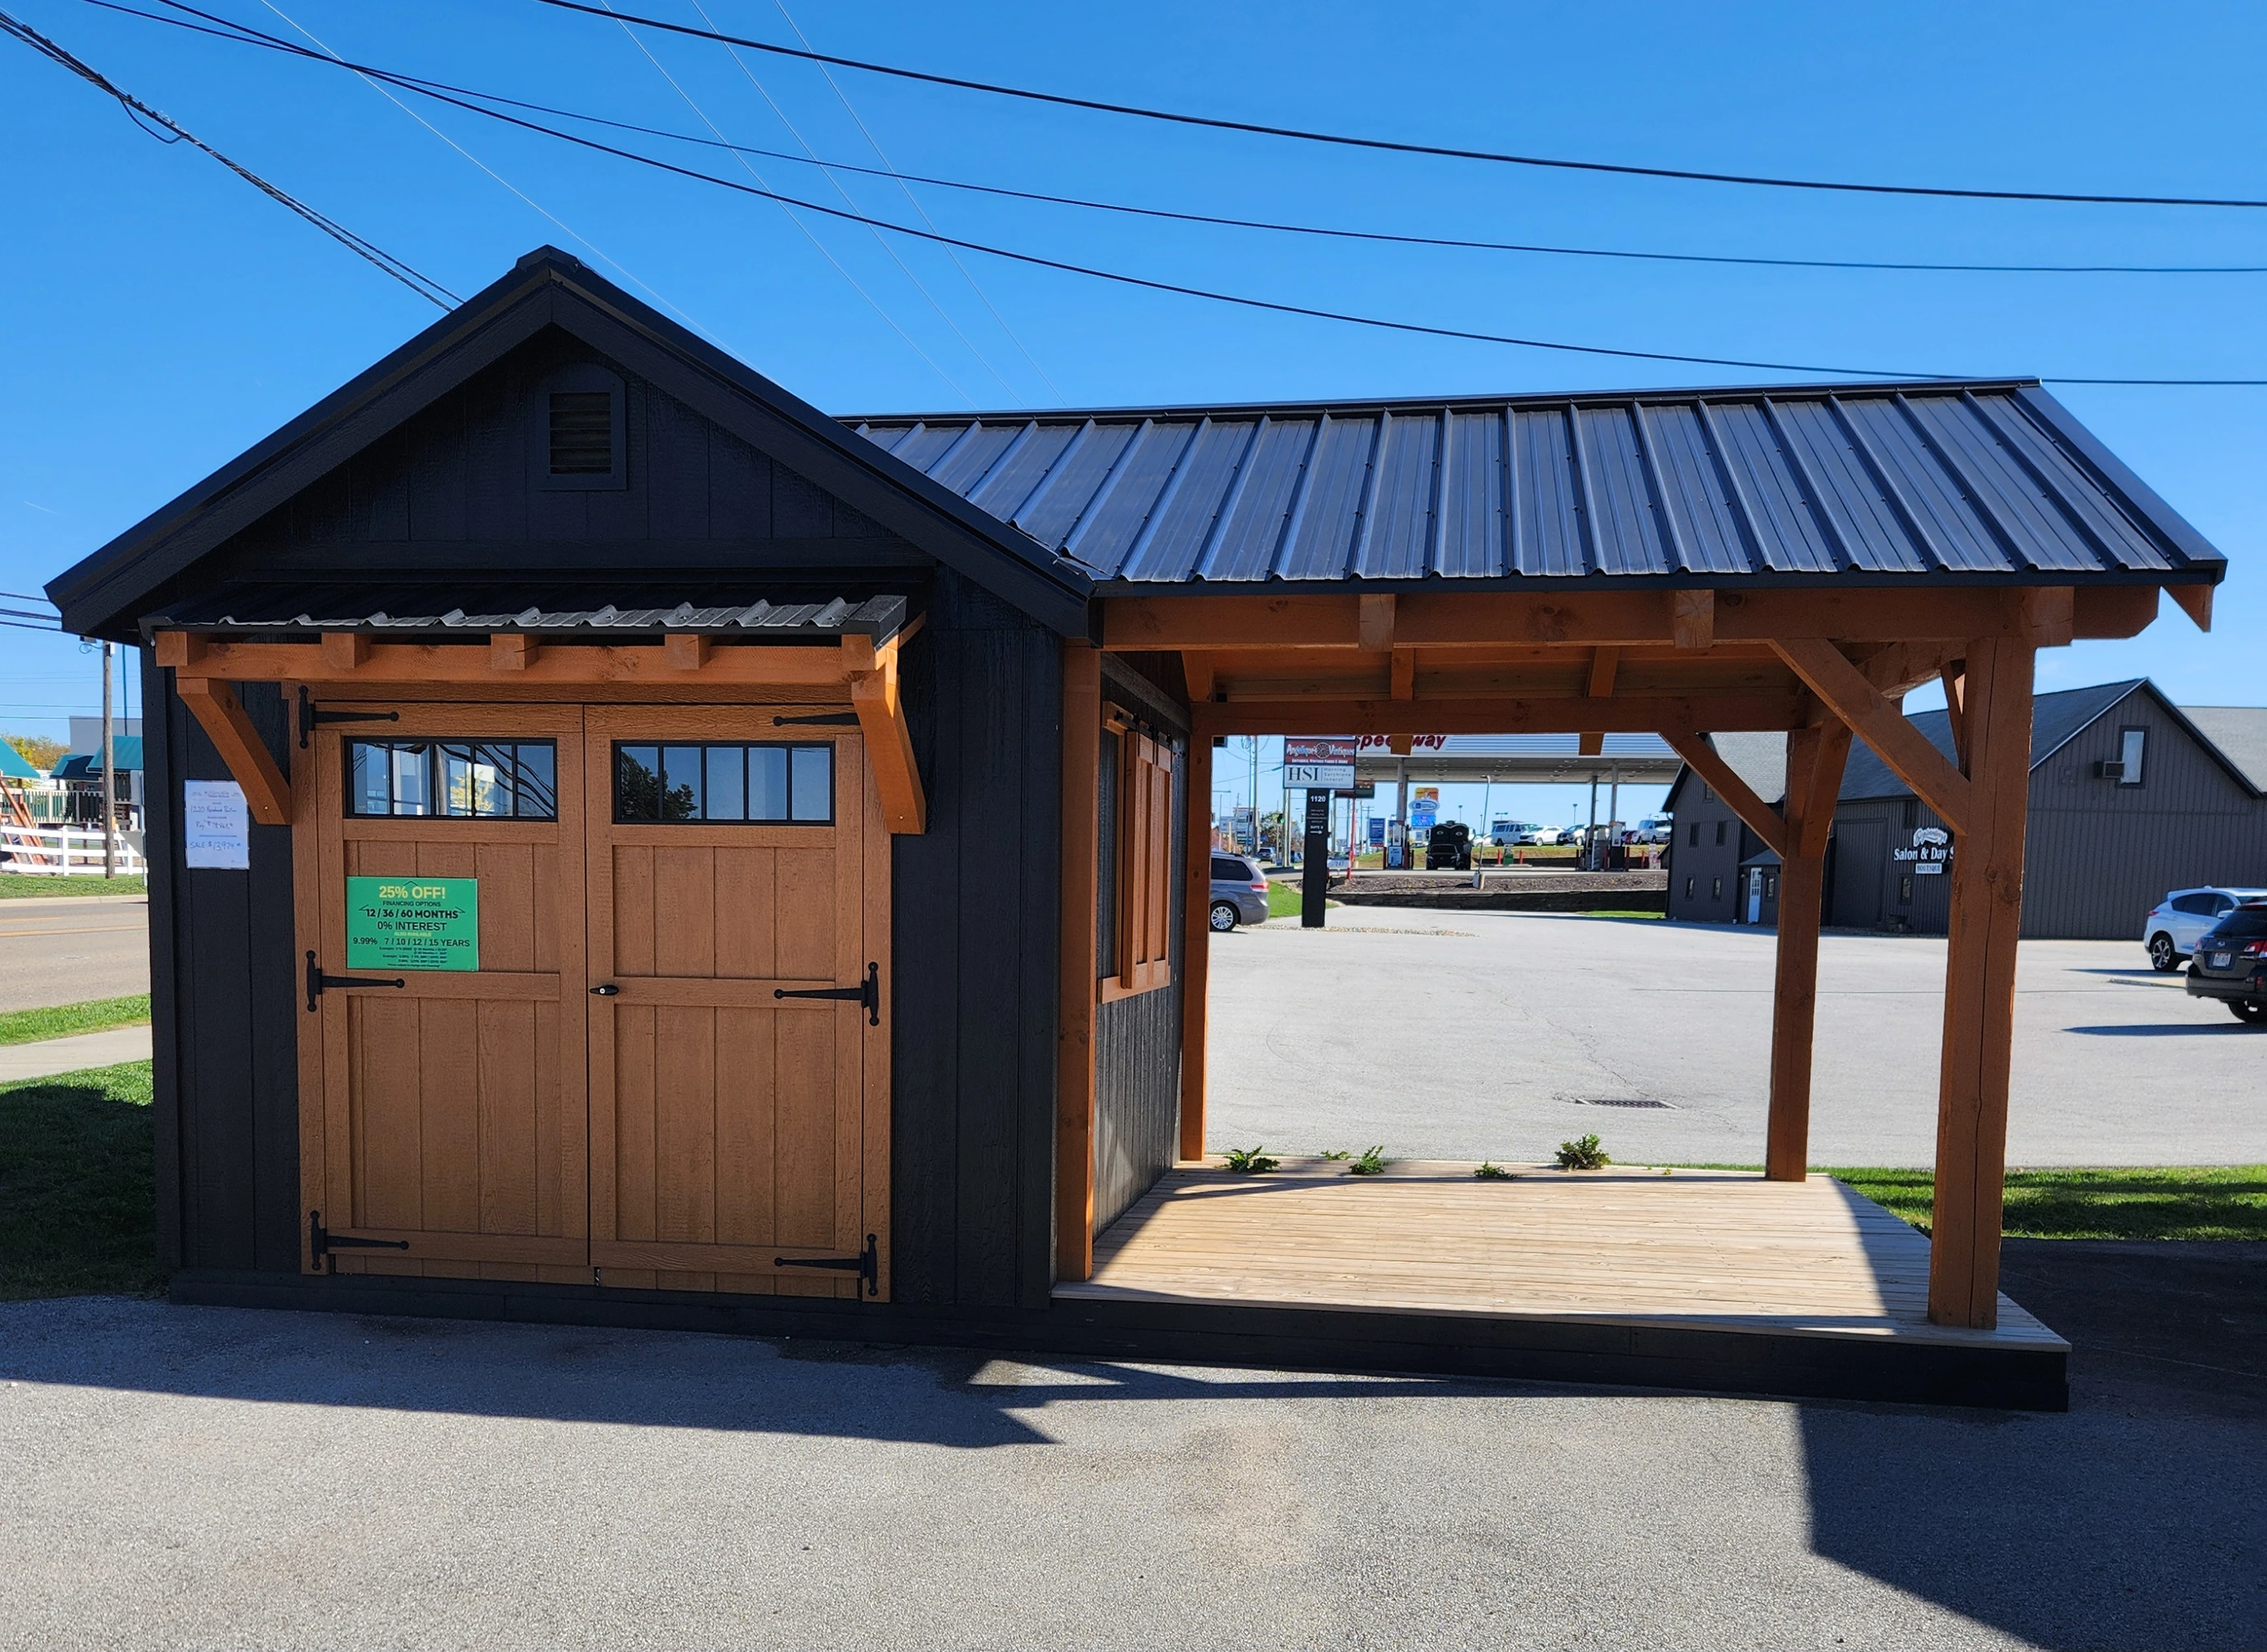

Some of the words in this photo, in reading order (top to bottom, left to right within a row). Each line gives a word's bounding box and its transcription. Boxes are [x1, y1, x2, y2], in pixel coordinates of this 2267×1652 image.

[1356, 735, 1447, 750] peeway
[1288, 767, 1320, 782] HSI
[1894, 847, 1918, 861] Salon
[1920, 847, 1929, 860] &
[1931, 847, 1948, 864] Day
[1916, 864, 1941, 873] BOUTIQUE
[379, 885, 408, 898] 25%
[411, 886, 446, 899] OFF!
[366, 909, 376, 917] 12
[383, 909, 393, 918] 36
[401, 910, 413, 918] 60
[415, 910, 458, 919] MONTHS
[377, 921, 393, 930] 0%
[395, 922, 447, 932] INTEREST
[352, 937, 377, 945] 9.99%
[412, 938, 423, 946] 12
[440, 939, 470, 947] YEARS
